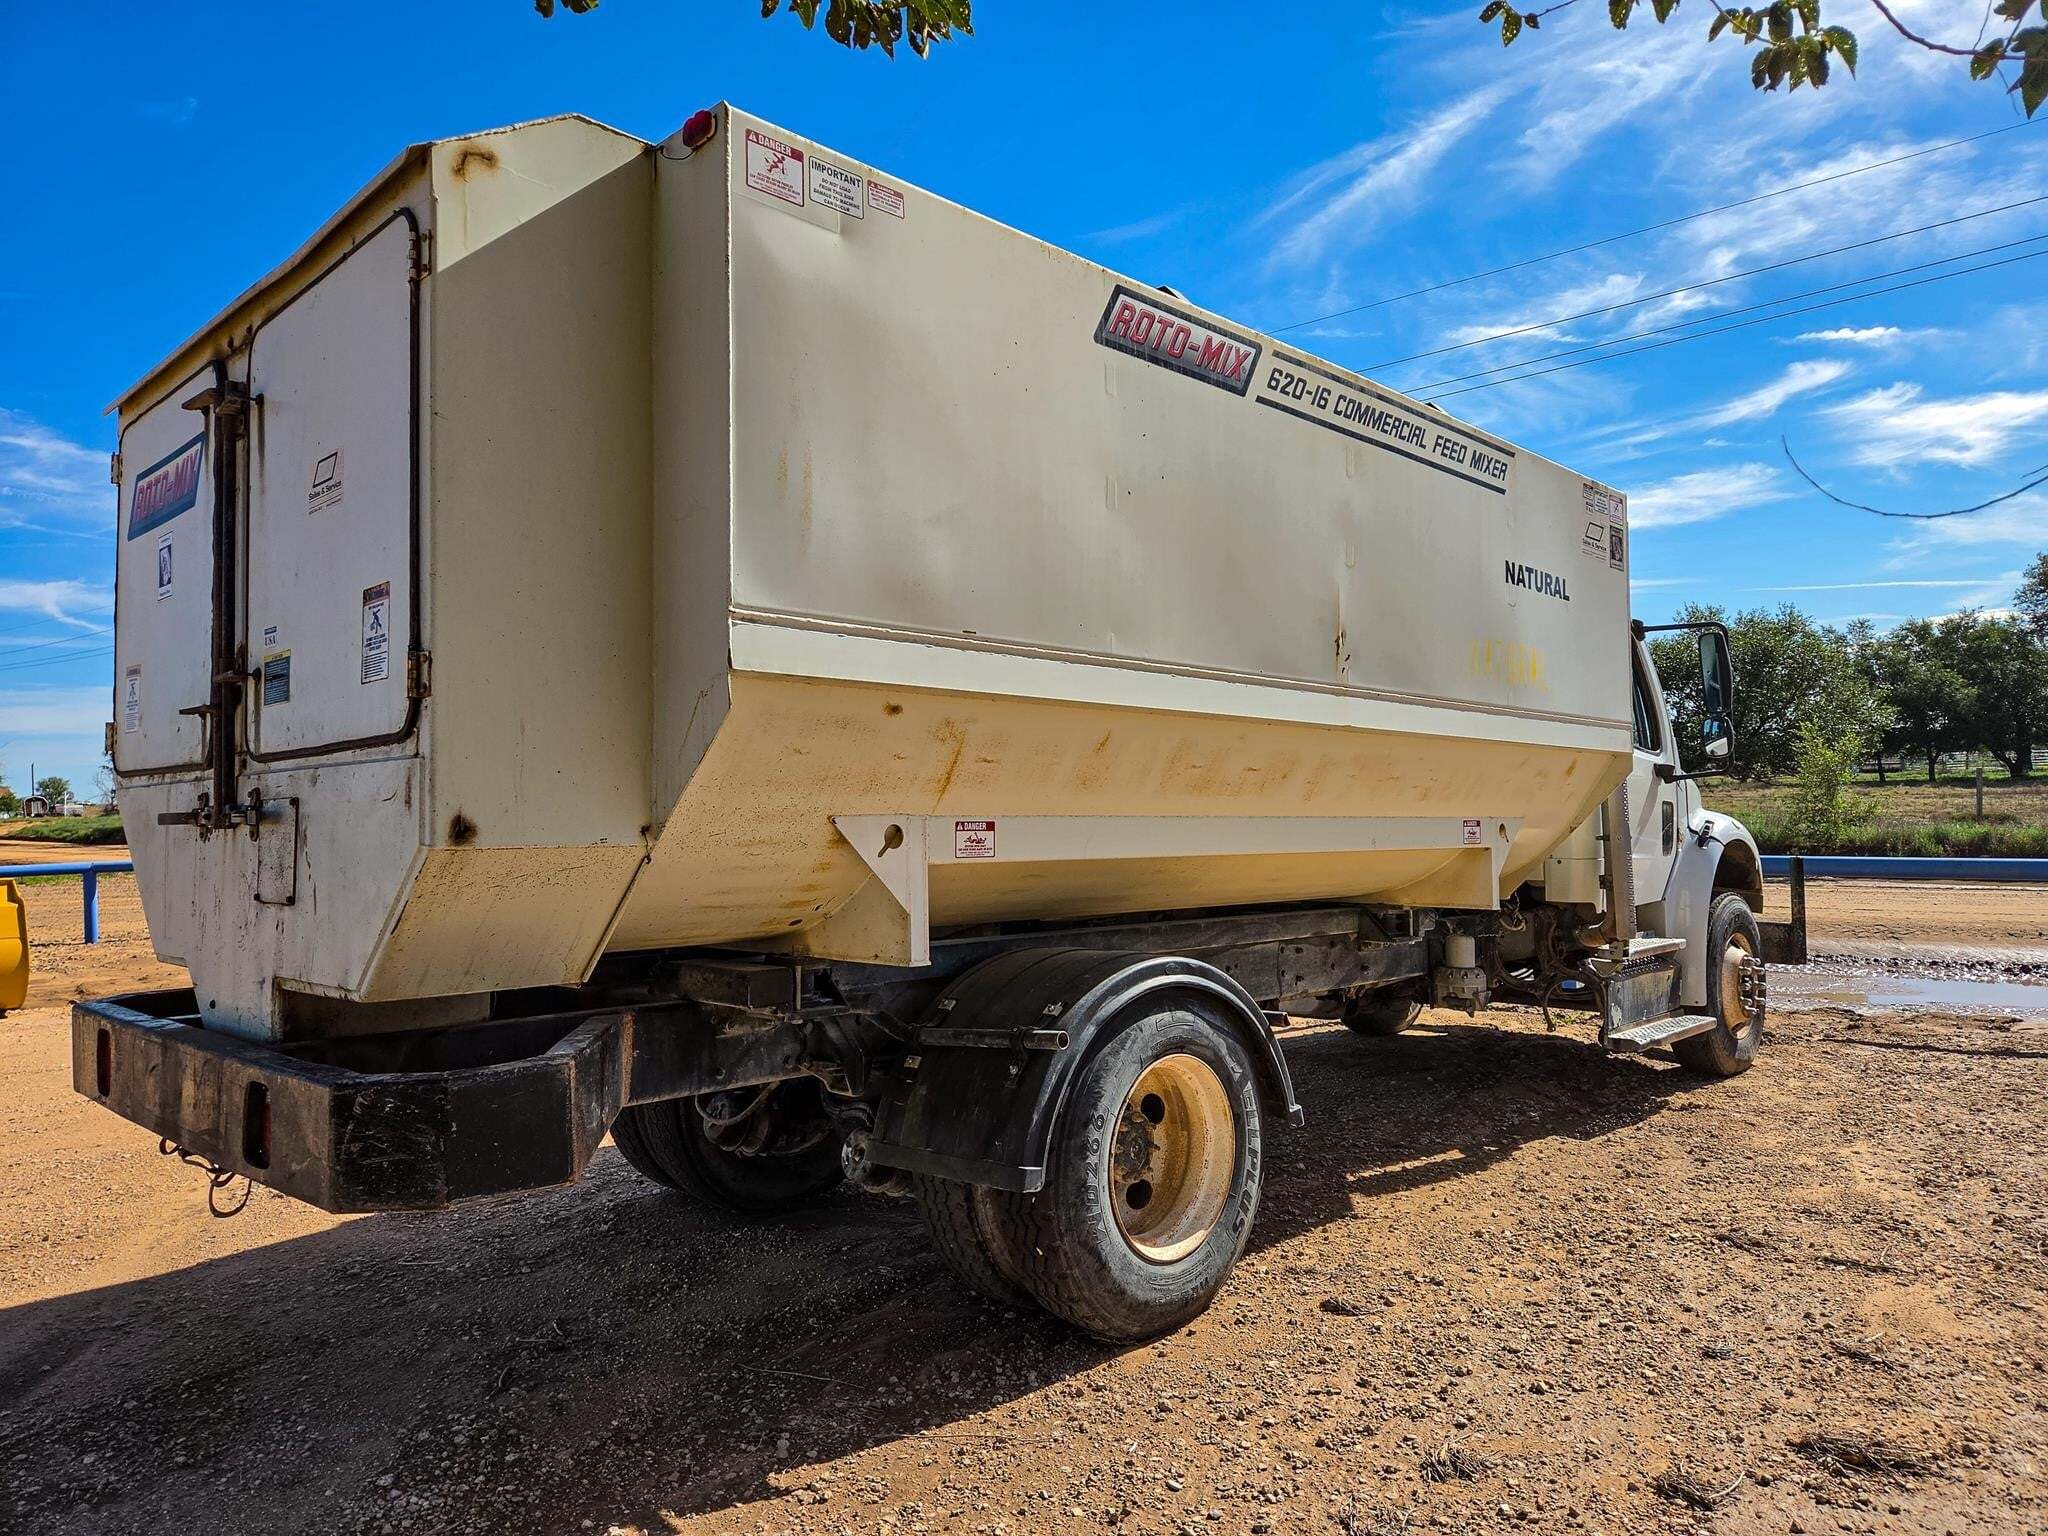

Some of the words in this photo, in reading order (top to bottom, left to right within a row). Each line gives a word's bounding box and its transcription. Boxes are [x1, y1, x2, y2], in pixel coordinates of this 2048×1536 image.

[759, 135, 792, 156] DANGER
[811, 160, 861, 188] IMPORTANT
[1109, 300, 1252, 384] ROTO-MIX
[1267, 368, 1329, 409] 620-16
[1334, 394, 1427, 449] COMMERCIAL
[1433, 435, 1466, 464] FEED
[1470, 449, 1508, 481] MIXER
[134, 449, 199, 520] ROTO-MIX
[1505, 560, 1570, 601] NATURAL
[964, 822, 987, 831] DANGER
